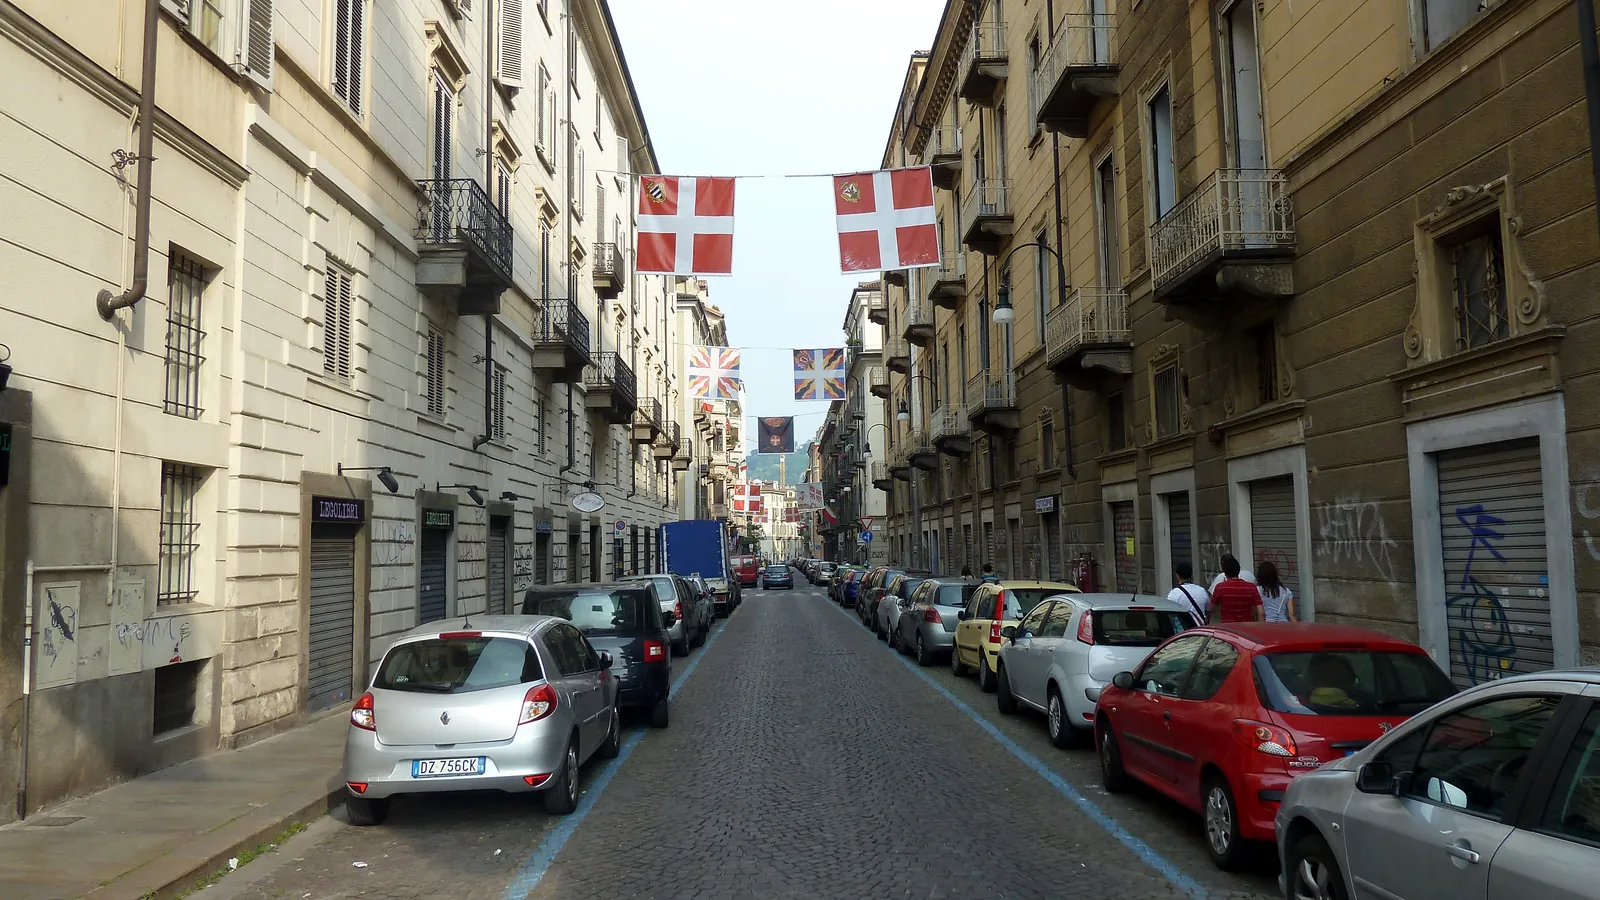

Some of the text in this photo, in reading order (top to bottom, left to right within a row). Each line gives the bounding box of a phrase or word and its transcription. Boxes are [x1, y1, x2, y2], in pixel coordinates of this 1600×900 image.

[320, 501, 359, 519] LEGOLIBRI
[426, 511, 450, 526] LEGOLIBRI
[421, 761, 436, 774] DZ
[440, 759, 477, 773] 756CK
